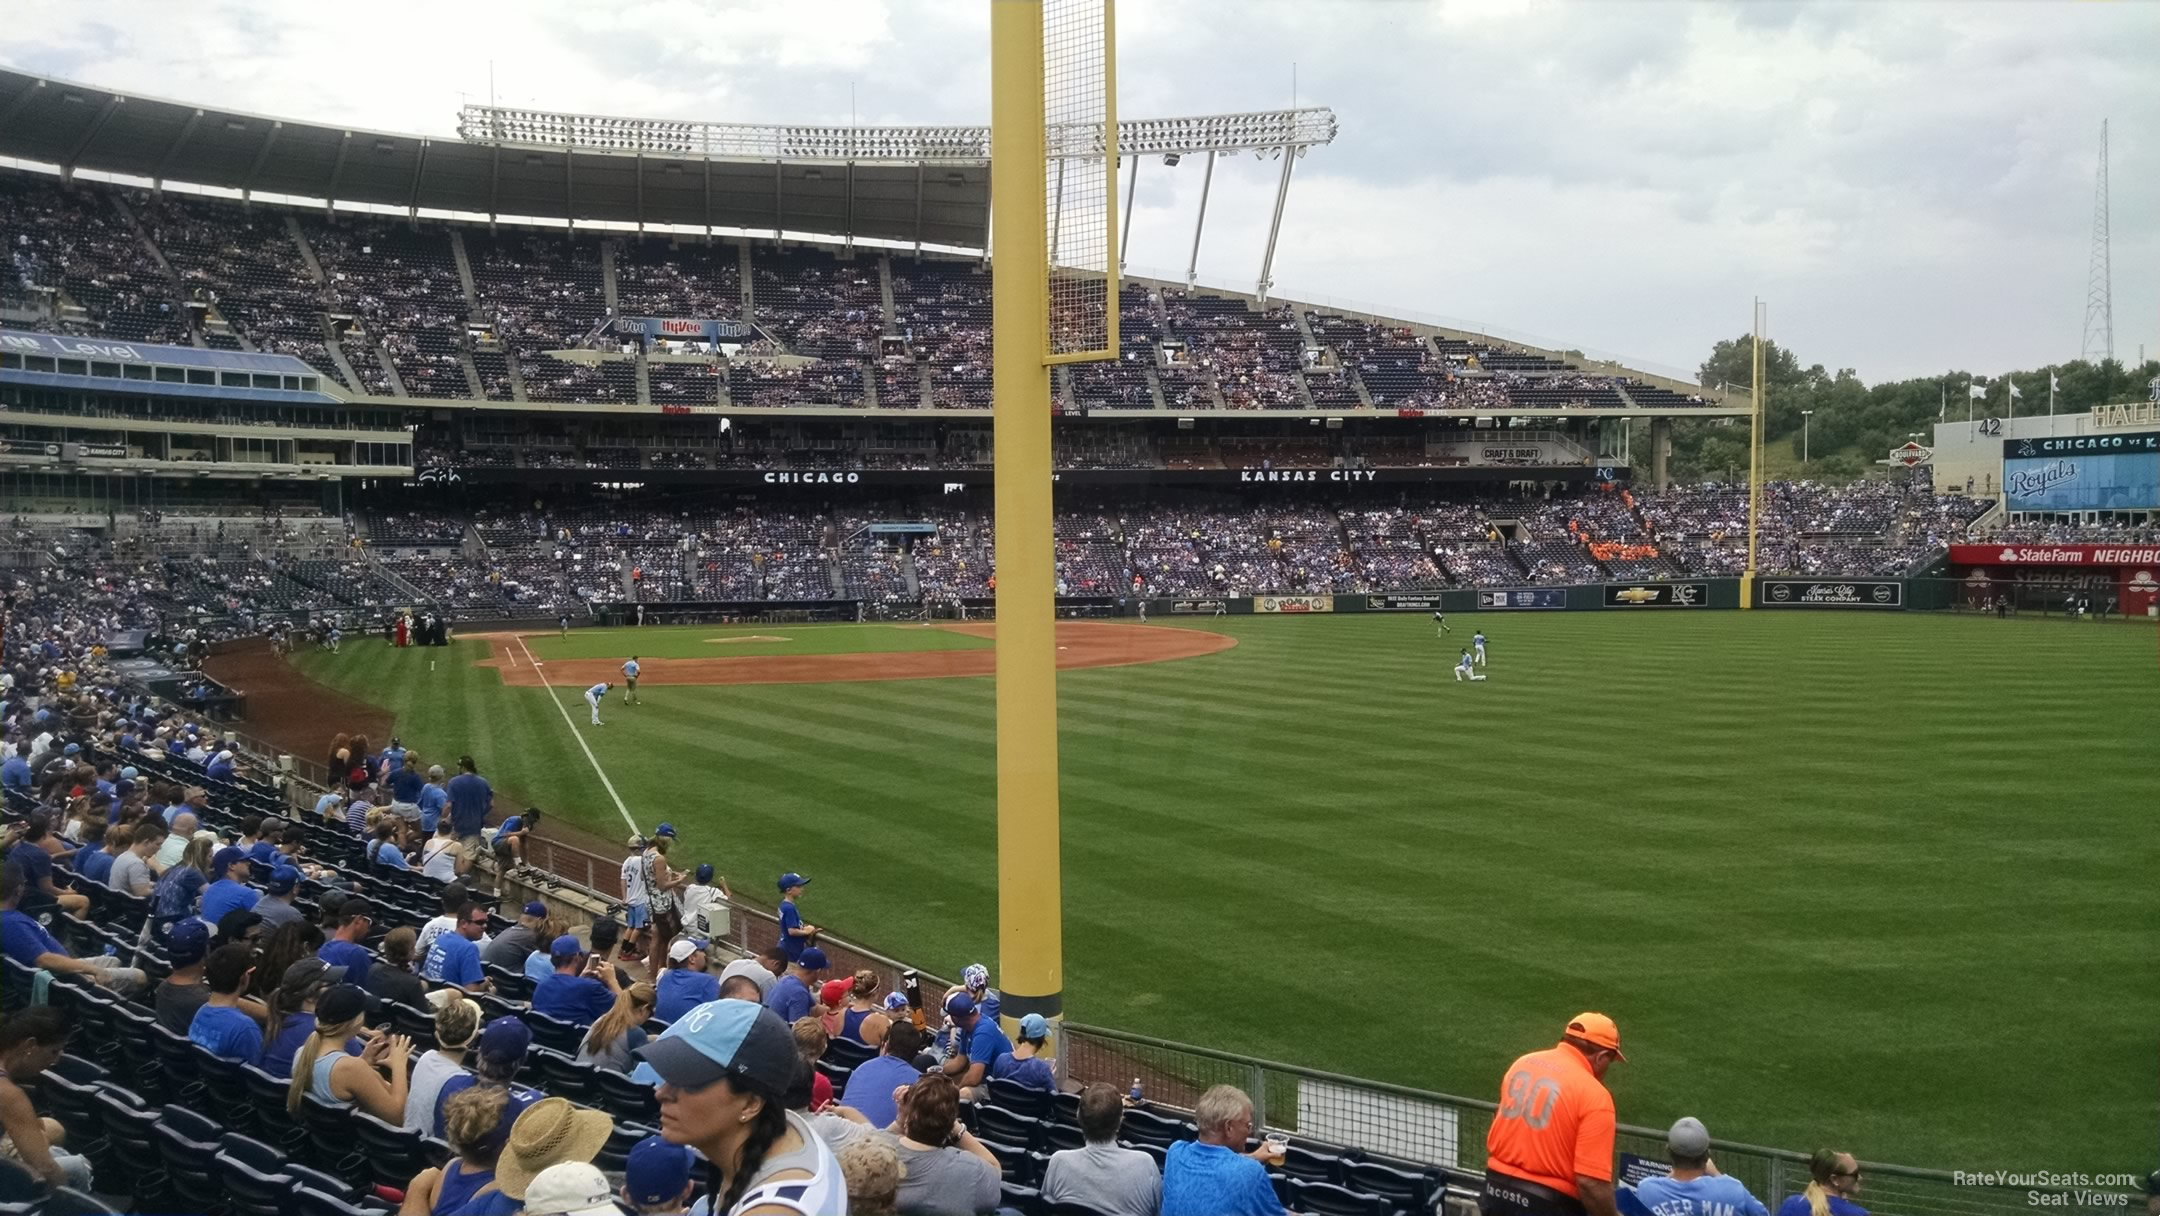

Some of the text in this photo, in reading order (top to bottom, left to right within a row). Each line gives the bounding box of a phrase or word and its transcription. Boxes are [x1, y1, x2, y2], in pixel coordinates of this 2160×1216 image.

[52, 338, 142, 359] Level
[1979, 418, 2002, 436] 42
[2043, 437, 2123, 450] CHICAGO
[1484, 449, 1539, 458] CRAFT & DRAFT
[763, 472, 859, 483] CHICAGO
[1241, 470, 1377, 481] KANSAS CITY
[2010, 459, 2078, 498] Royals
[2018, 548, 2083, 562] StateFarm
[1501, 1070, 1560, 1130] 90
[1638, 1158, 1673, 1172] WARNING
[1486, 1182, 1530, 1208] lacoste
[1652, 1199, 1735, 1216] BEER MAN
